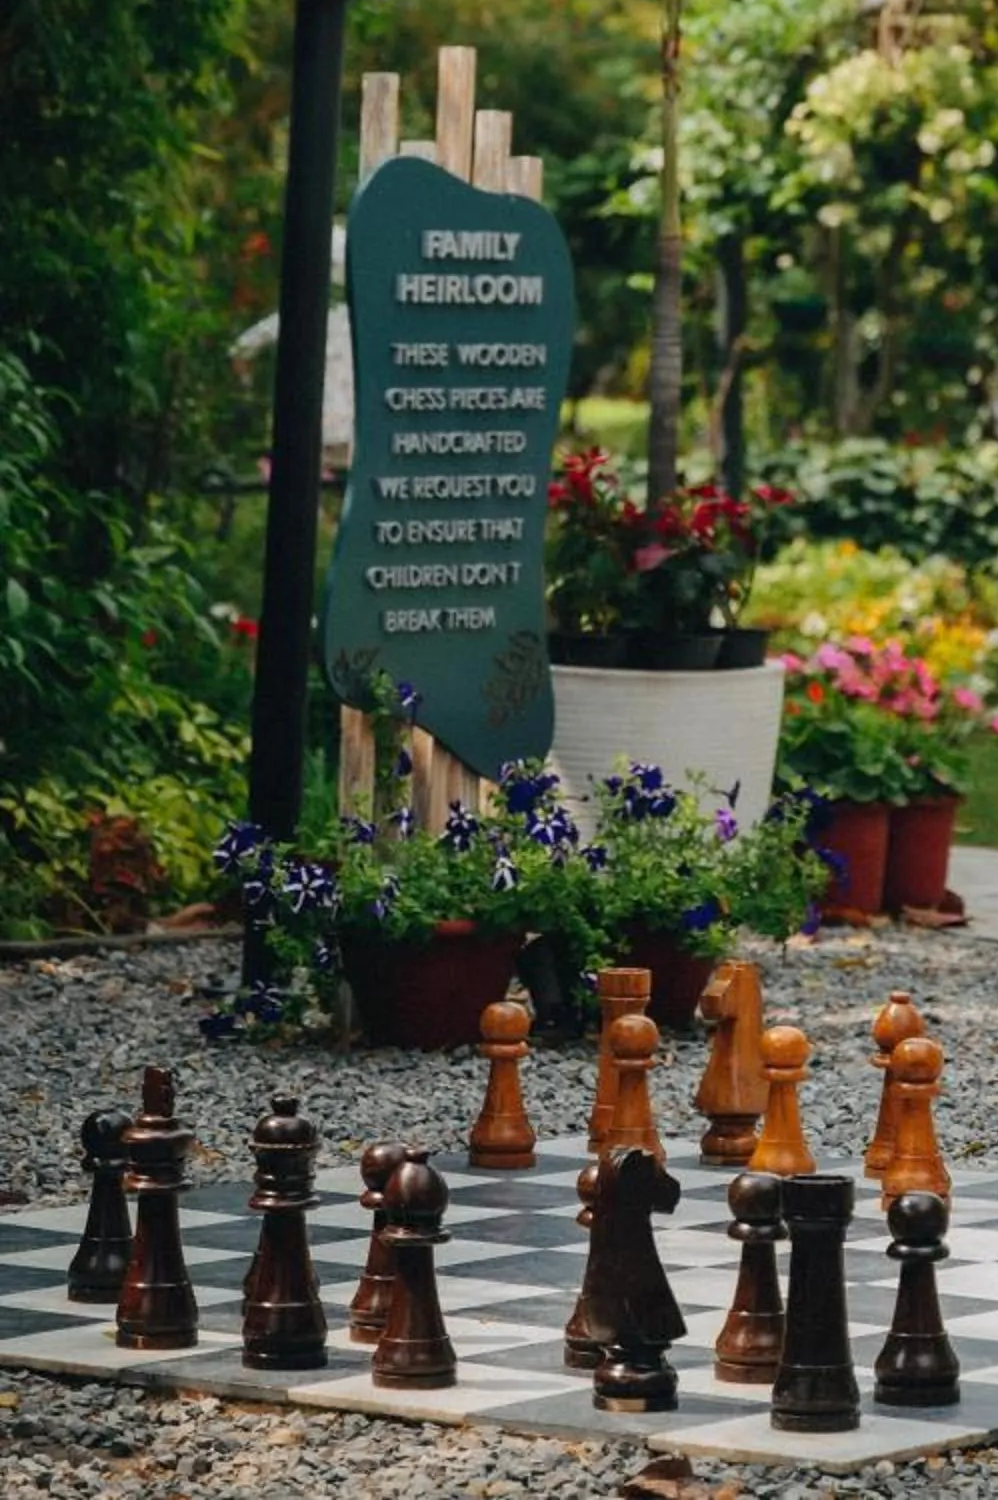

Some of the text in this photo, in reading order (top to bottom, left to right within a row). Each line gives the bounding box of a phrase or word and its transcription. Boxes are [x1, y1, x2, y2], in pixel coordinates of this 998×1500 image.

[421, 229, 521, 261] FAMILY
[396, 273, 543, 305] HEIRLOOM
[390, 342, 547, 367] THESE WOODEN
[384, 386, 546, 410] CHESS PIECES ARE
[393, 430, 527, 454] HANDCRAFTED
[376, 473, 536, 499] WE REQUEST YOU
[376, 516, 525, 544] TO ENSURE THAT
[366, 563, 458, 589] CHILDREN
[384, 605, 497, 633] BREAK THEM
